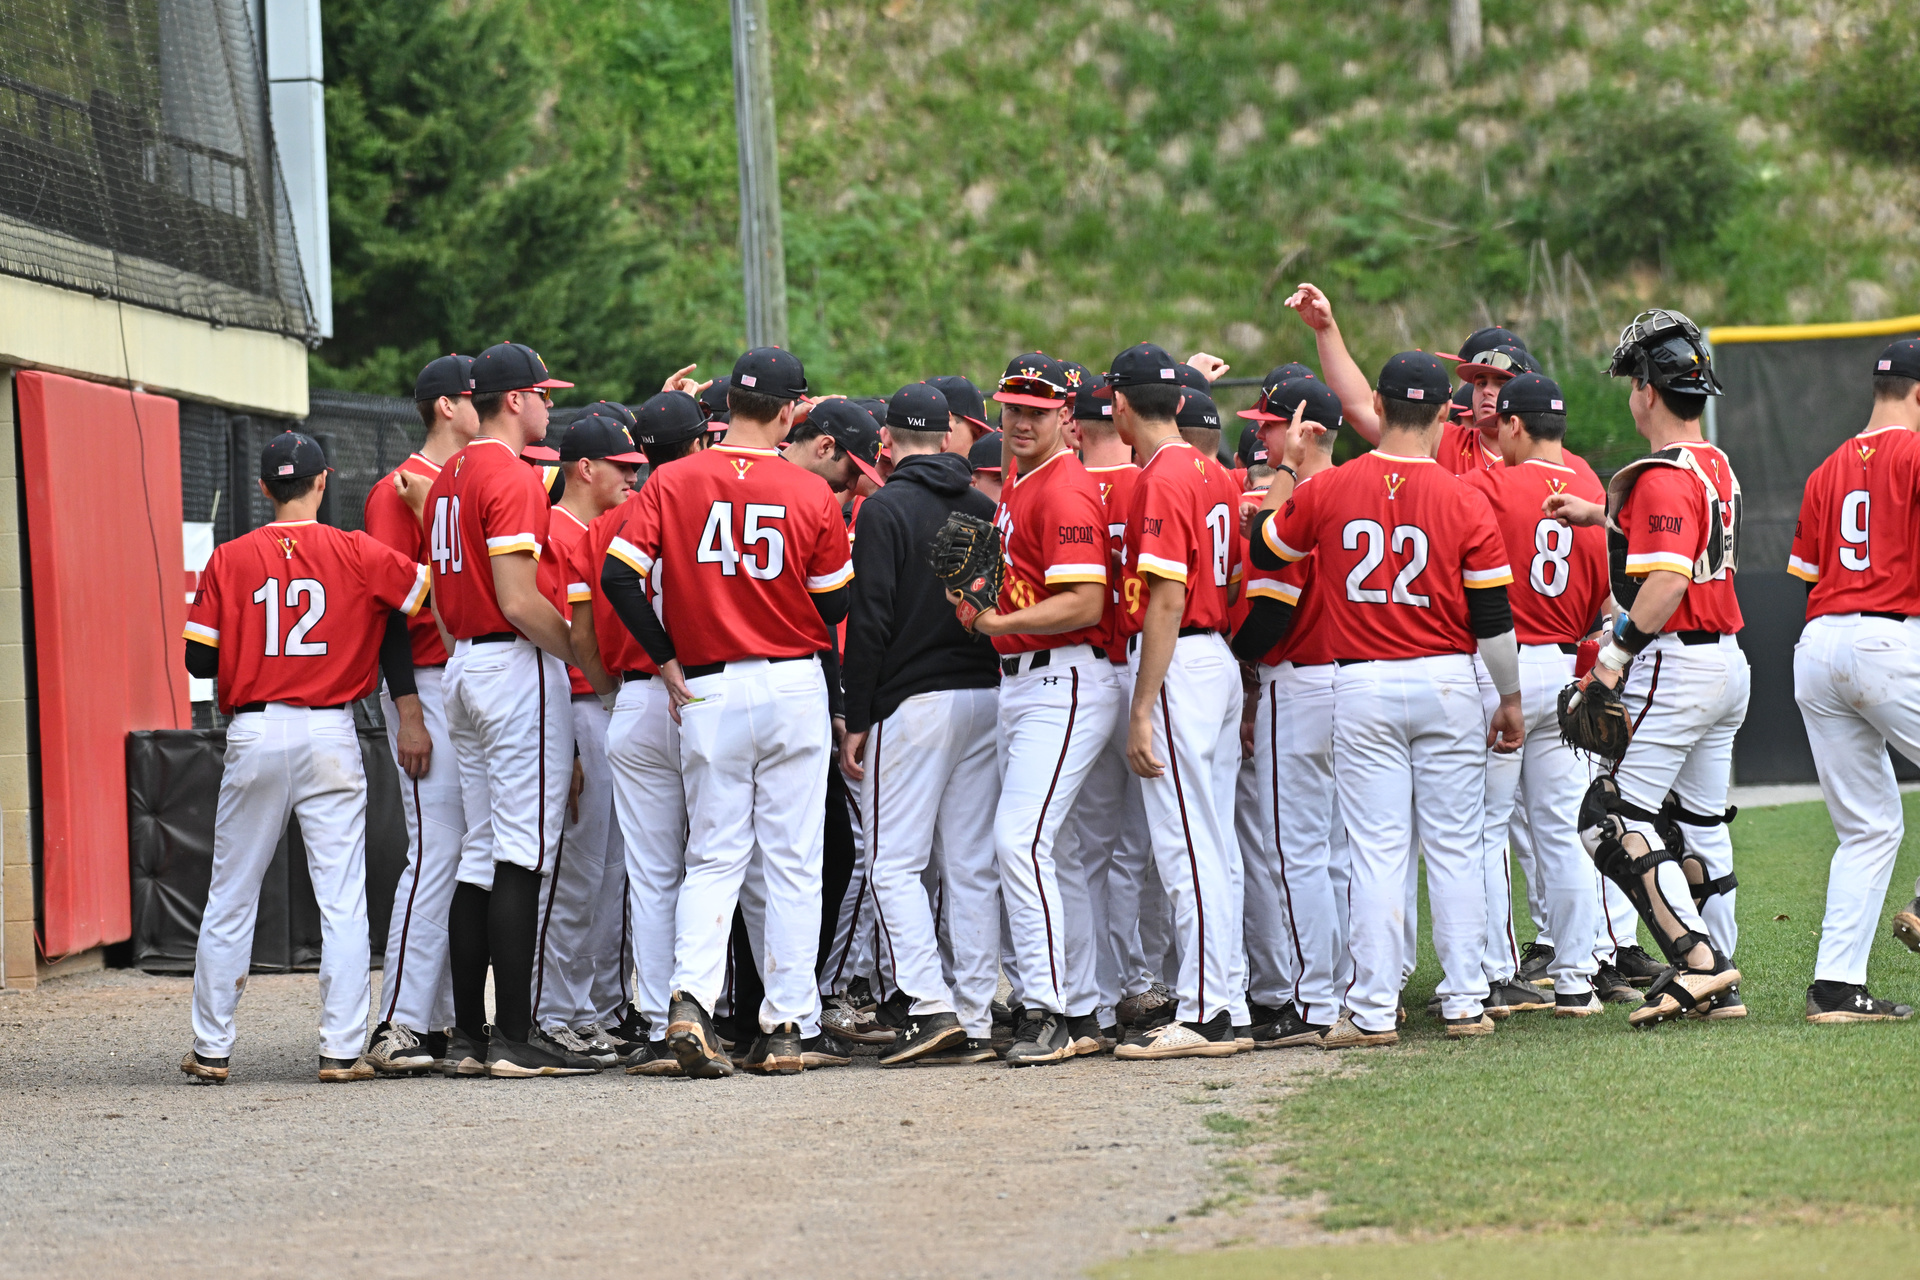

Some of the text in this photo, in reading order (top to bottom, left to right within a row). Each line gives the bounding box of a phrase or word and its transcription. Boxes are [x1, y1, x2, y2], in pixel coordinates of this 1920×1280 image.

[907, 416, 926, 427] VMI
[431, 494, 463, 575] 40
[696, 500, 787, 581] 45
[1142, 517, 1163, 538] CON
[1342, 518, 1431, 608] 22
[1529, 518, 1574, 597] 8
[1839, 489, 1871, 572] 9
[253, 577, 328, 657] 12
